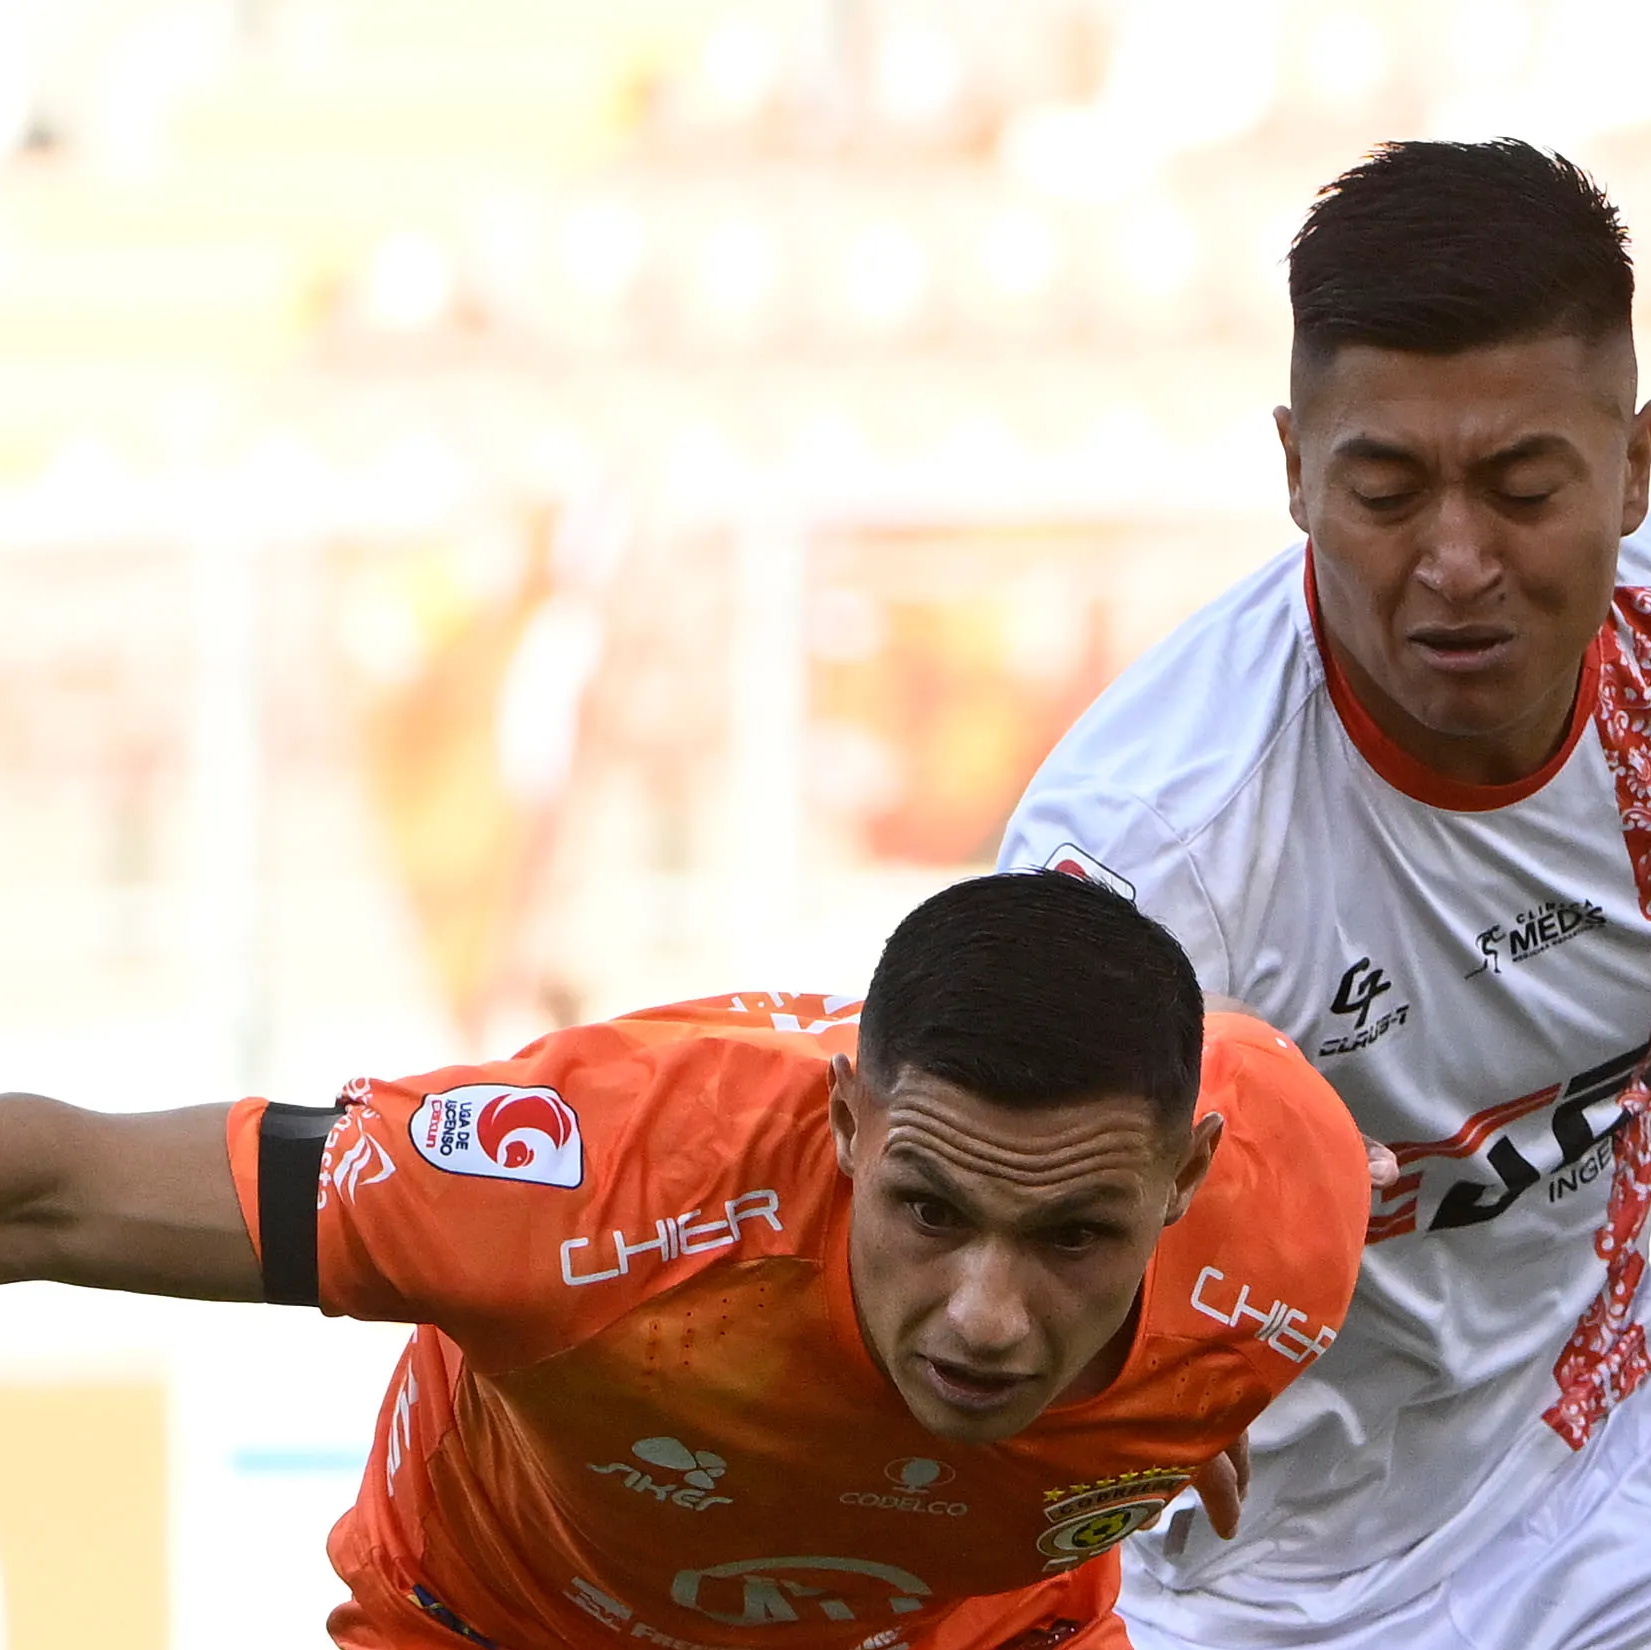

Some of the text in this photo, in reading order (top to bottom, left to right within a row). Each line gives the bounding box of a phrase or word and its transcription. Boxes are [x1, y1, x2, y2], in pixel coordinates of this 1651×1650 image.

[1509, 906, 1607, 955] MEDS
[455, 1131, 471, 1151] DE
[560, 1189, 784, 1287] CHIER
[839, 1492, 968, 1517] CODELCO
